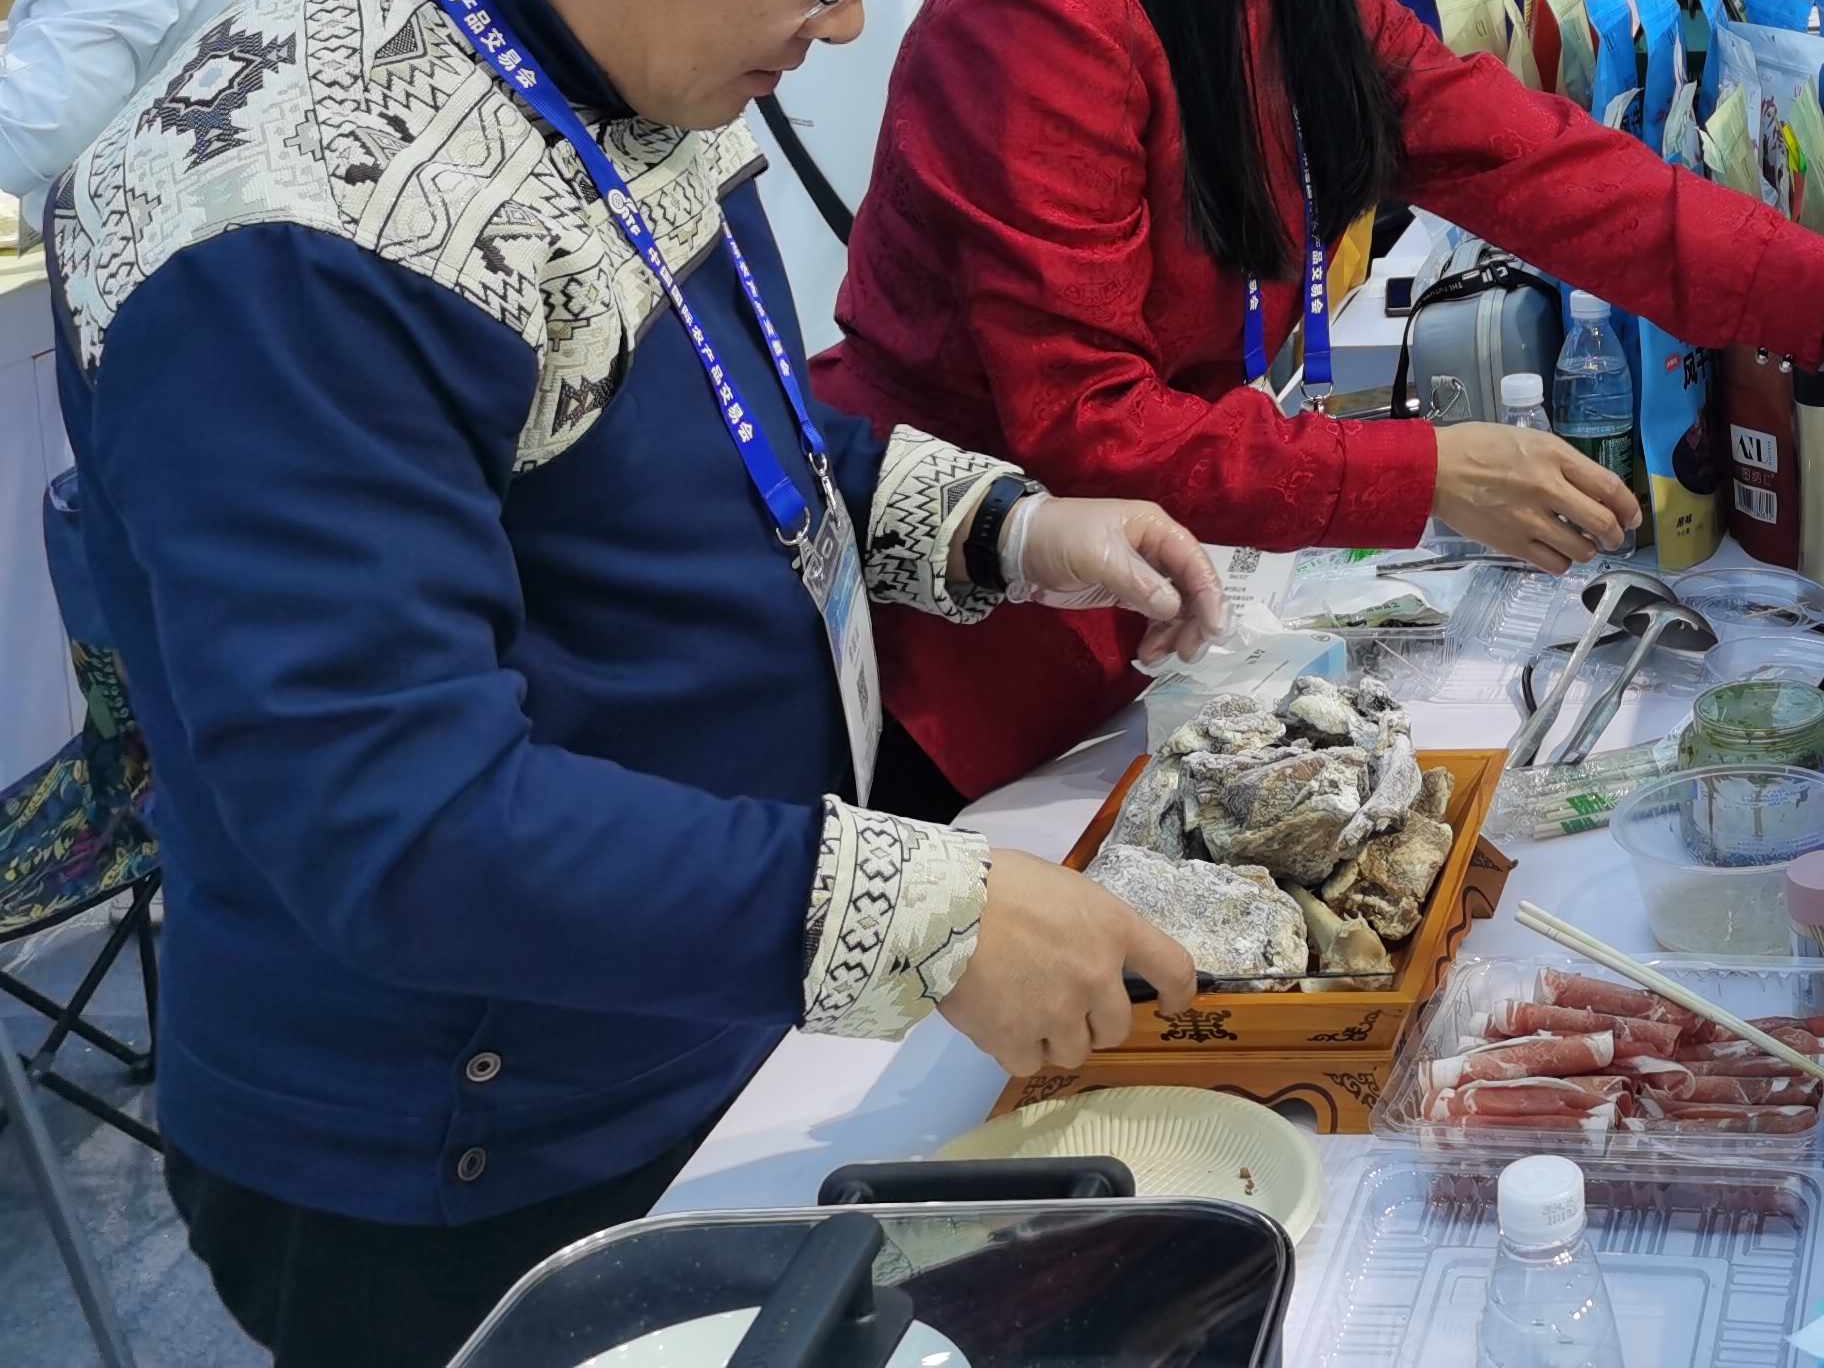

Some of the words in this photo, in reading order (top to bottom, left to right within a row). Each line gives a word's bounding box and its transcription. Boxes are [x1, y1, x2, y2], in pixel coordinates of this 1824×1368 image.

[647, 246, 755, 444] 中国国际农产品交易会
